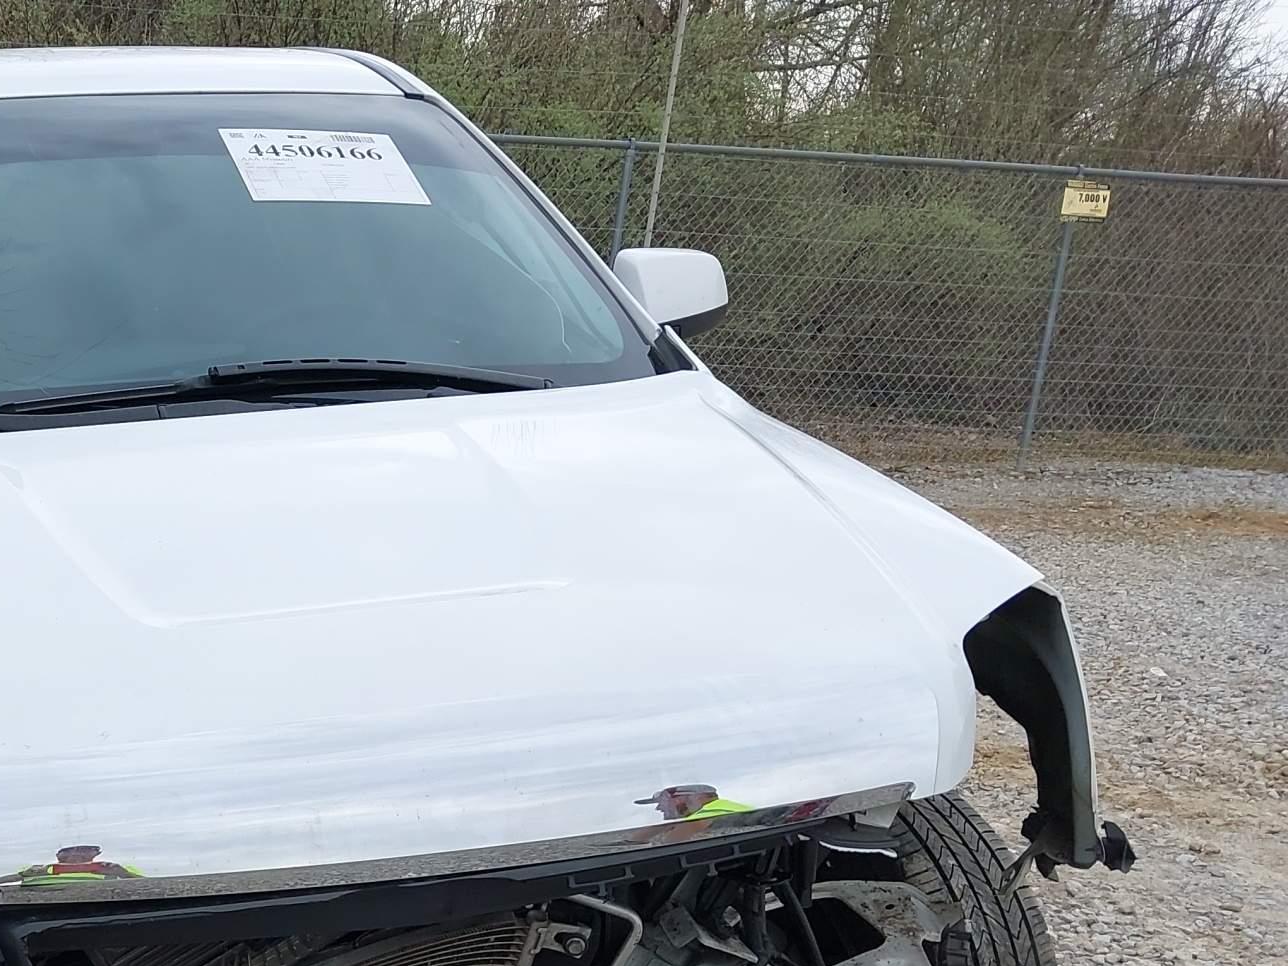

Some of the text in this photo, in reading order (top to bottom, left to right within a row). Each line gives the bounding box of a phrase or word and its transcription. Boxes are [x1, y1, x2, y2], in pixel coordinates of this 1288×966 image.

[248, 143, 383, 161] 44506166
[1078, 192, 1108, 204] 7,000 V
